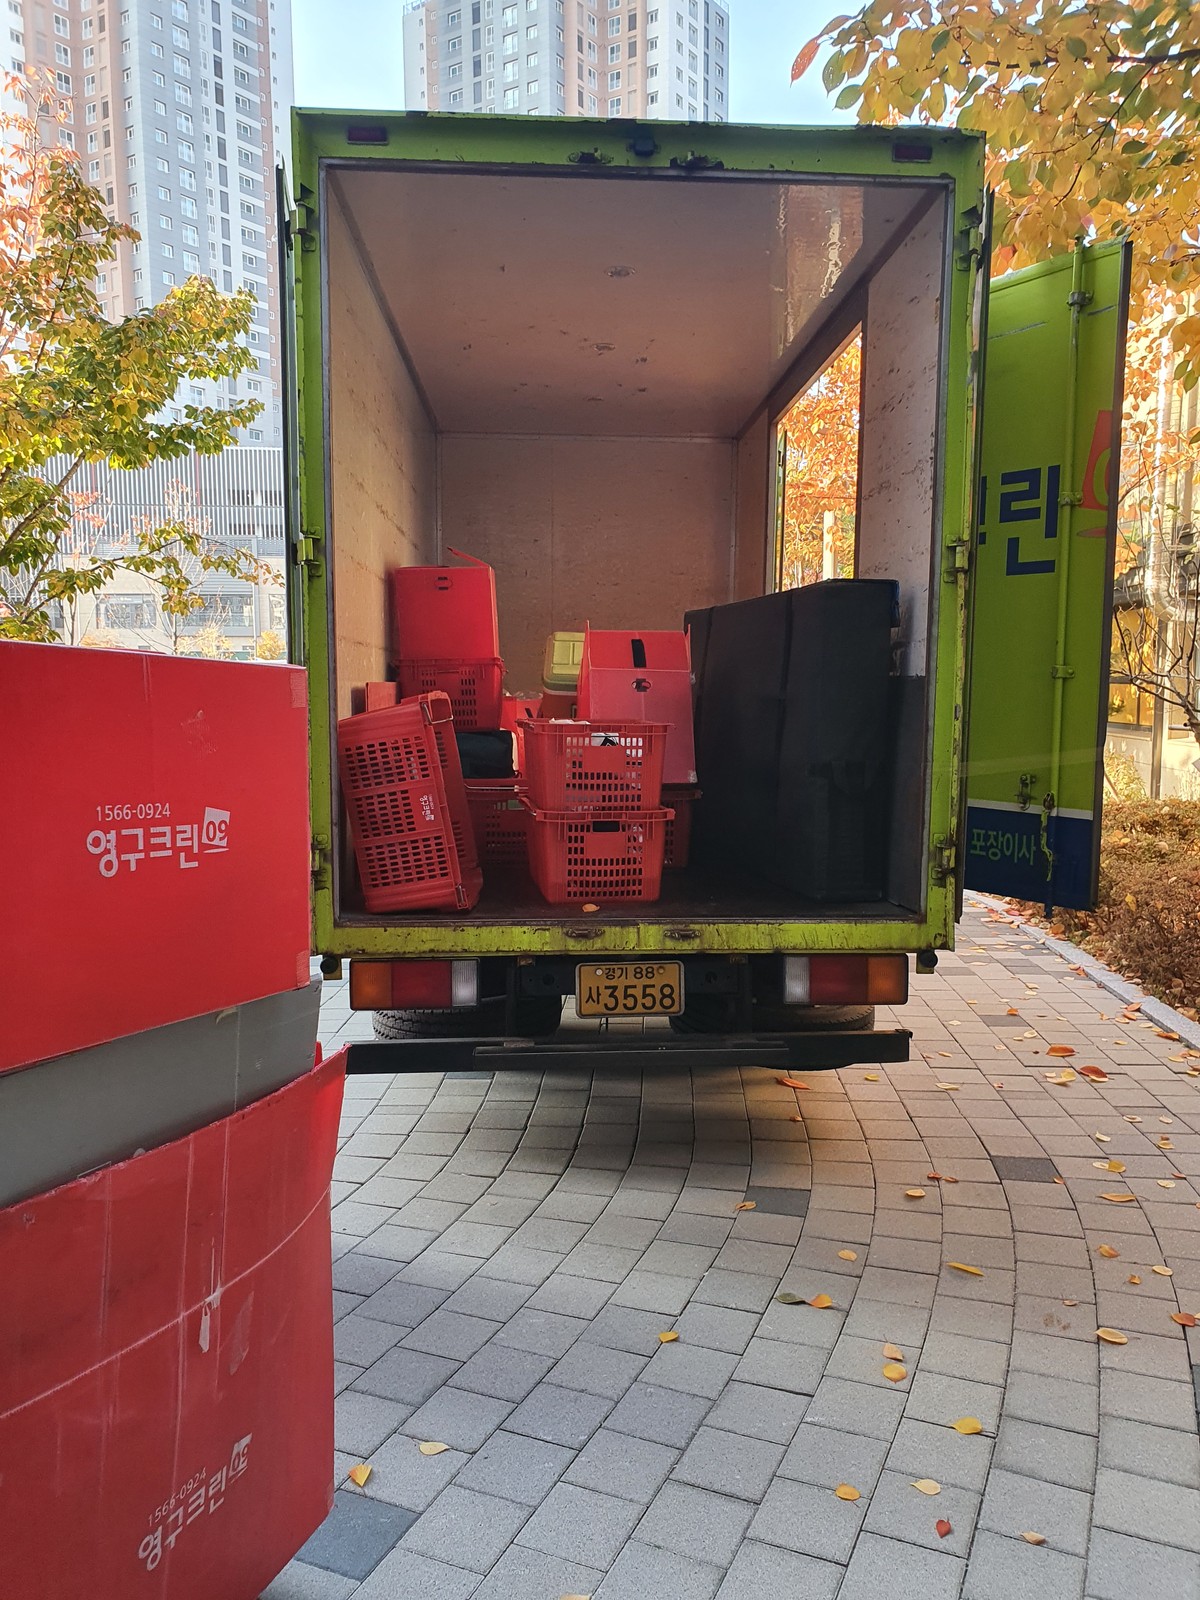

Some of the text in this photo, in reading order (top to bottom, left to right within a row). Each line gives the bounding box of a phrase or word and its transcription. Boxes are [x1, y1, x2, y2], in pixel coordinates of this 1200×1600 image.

[979, 464, 1060, 576] 린
[96, 803, 171, 821] 1566-0924
[970, 828, 1036, 866] 포장이사
[604, 966, 655, 980] 경기 88
[148, 1467, 207, 1526] 1566-0924
